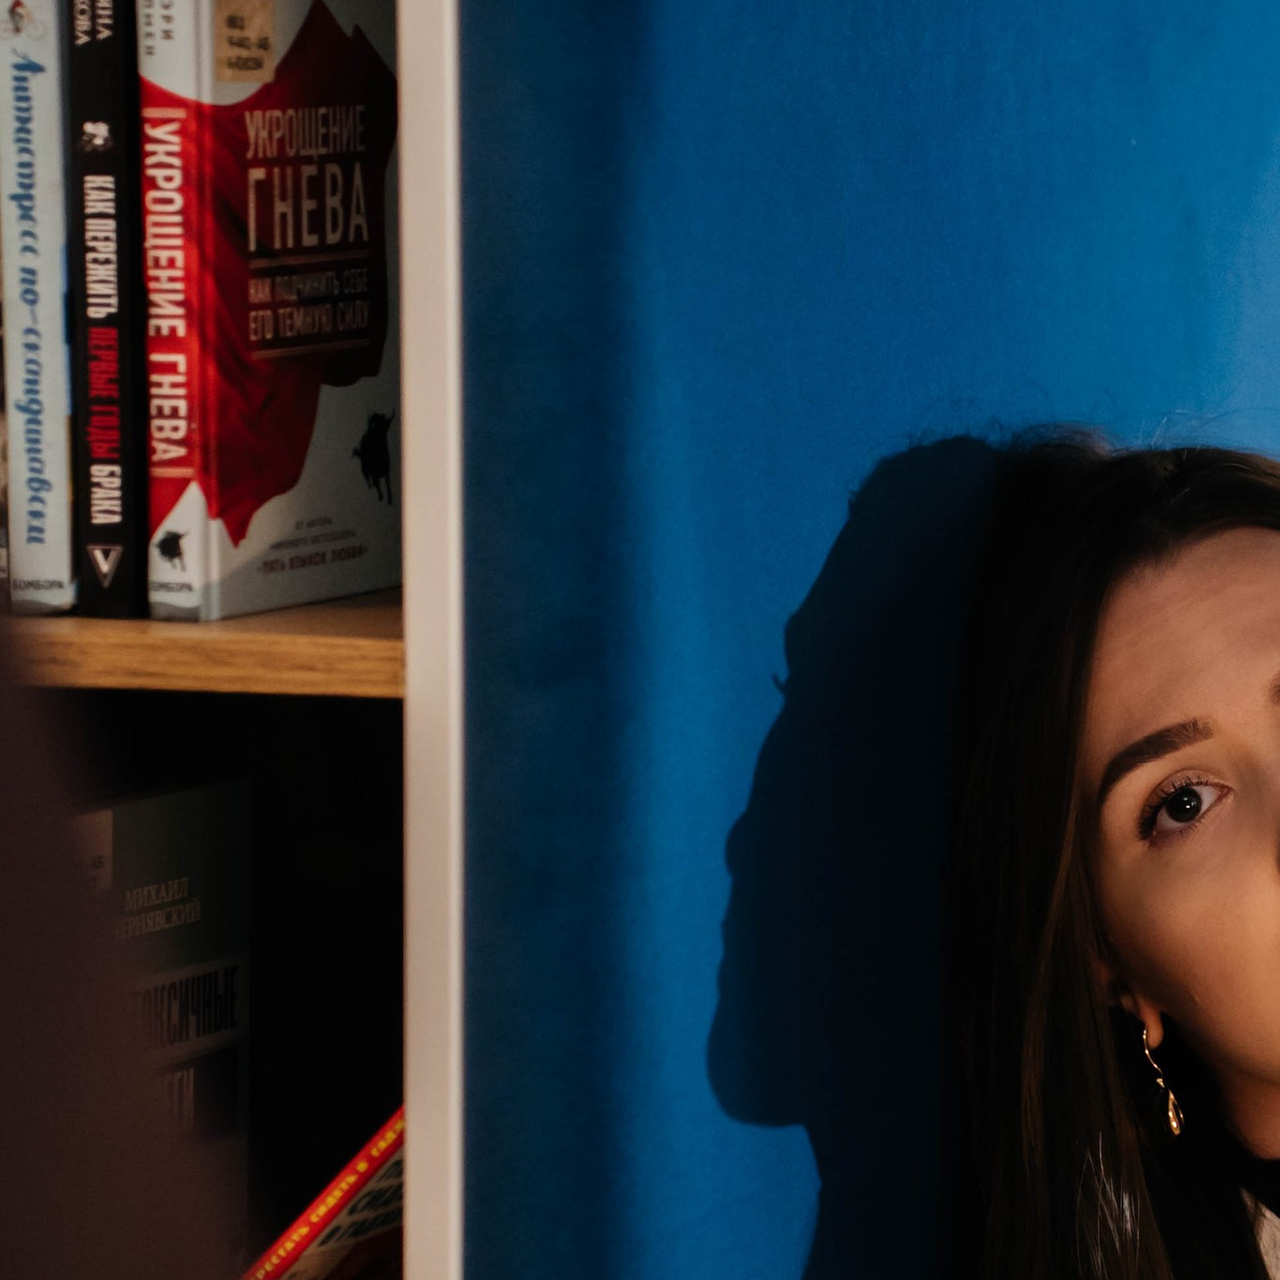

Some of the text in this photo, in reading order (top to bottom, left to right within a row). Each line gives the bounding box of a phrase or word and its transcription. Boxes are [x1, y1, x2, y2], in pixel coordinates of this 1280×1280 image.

[244, 104, 367, 163] УКРОЩЕНИЕ
[247, 160, 370, 253] ГНЕВА
[143, 123, 188, 462] УКРОЩЕНИЕ ГНЕВА
[248, 309, 275, 342] ЕГО
[83, 175, 122, 525] КАК ПЕРЕЖИТЬ ПЕРВЫЕ ГОДЫ БРАКА
[117, 897, 201, 940] ЕРНЯВСКИЙ
[125, 877, 189, 912] МИХАИЛ
[133, 966, 239, 1050] ОКСИЧНЫЕ
